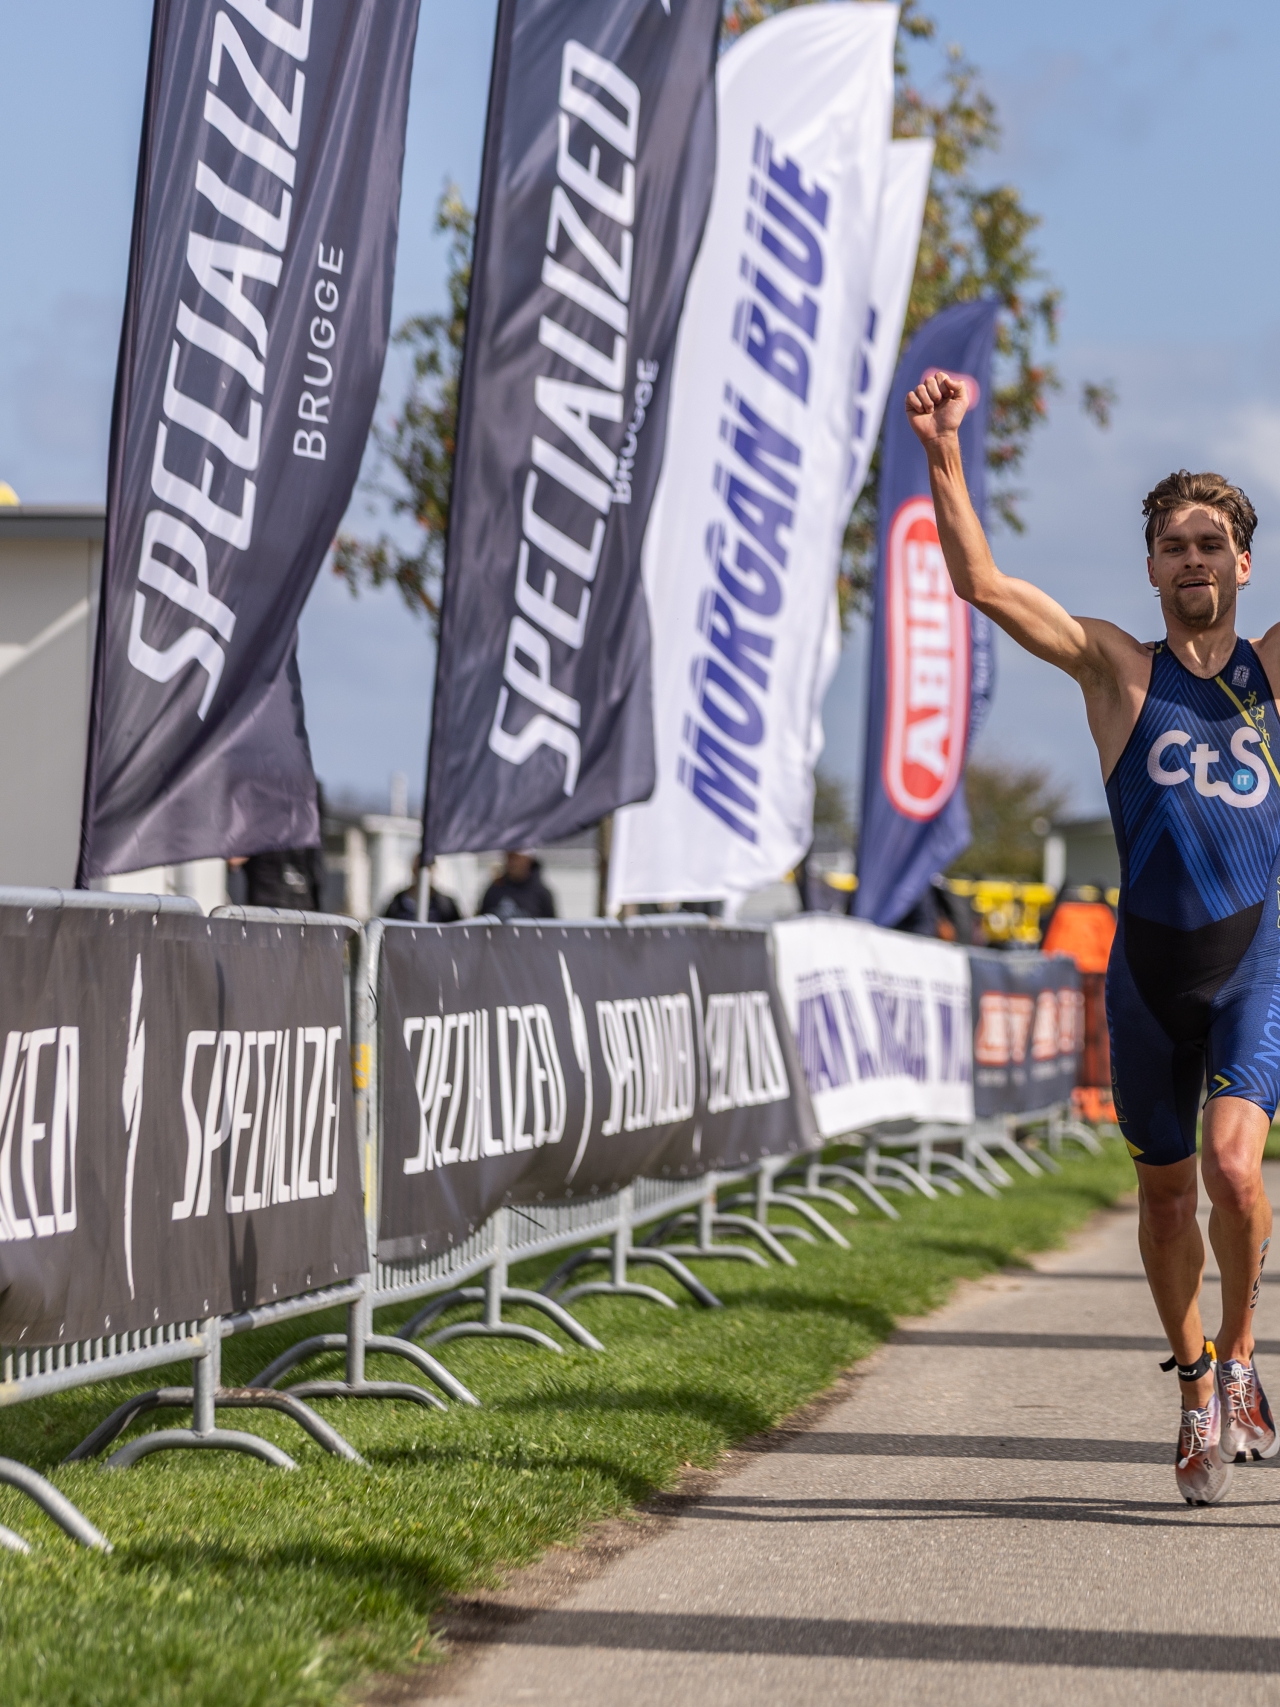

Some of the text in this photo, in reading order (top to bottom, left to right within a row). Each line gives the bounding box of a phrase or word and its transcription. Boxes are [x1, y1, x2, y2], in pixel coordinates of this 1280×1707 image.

[292, 243, 345, 462] BRUGGE
[487, 39, 641, 797] SPECIALIZED
[677, 124, 831, 845] MORGAN BLUE
[904, 538, 953, 780] ABUS
[1147, 726, 1270, 808] CtS
[1236, 774, 1250, 786] IT
